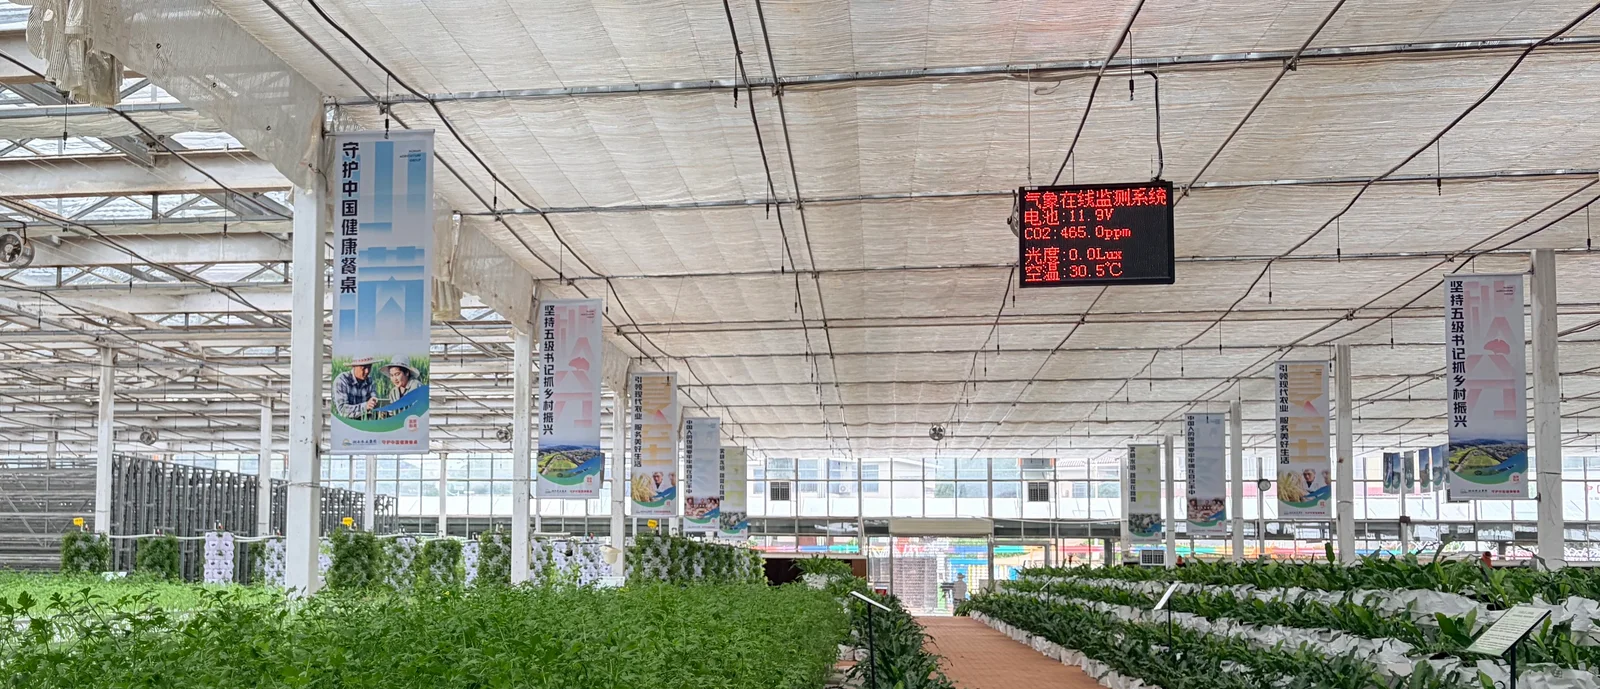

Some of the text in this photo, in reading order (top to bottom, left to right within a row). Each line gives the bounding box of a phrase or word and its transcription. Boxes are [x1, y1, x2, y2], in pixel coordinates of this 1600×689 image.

[340, 141, 359, 294] 守护中国健康餐桌
[1024, 187, 1167, 209] 气象在线监测系统
[1024, 208, 1115, 226] 电池:11.9V
[1024, 225, 1132, 240] CO2:465.0ppm
[1024, 246, 1123, 265] 光度:0.0Lux
[543, 305, 555, 436] 坚持五级书记抓乡村振兴
[1450, 281, 1467, 427] 坚持五级书记抓乡村振兴
[633, 376, 642, 468] 引领现代农业 服务美好生活
[1279, 364, 1290, 465] 引领现代农业 服务美好生活
